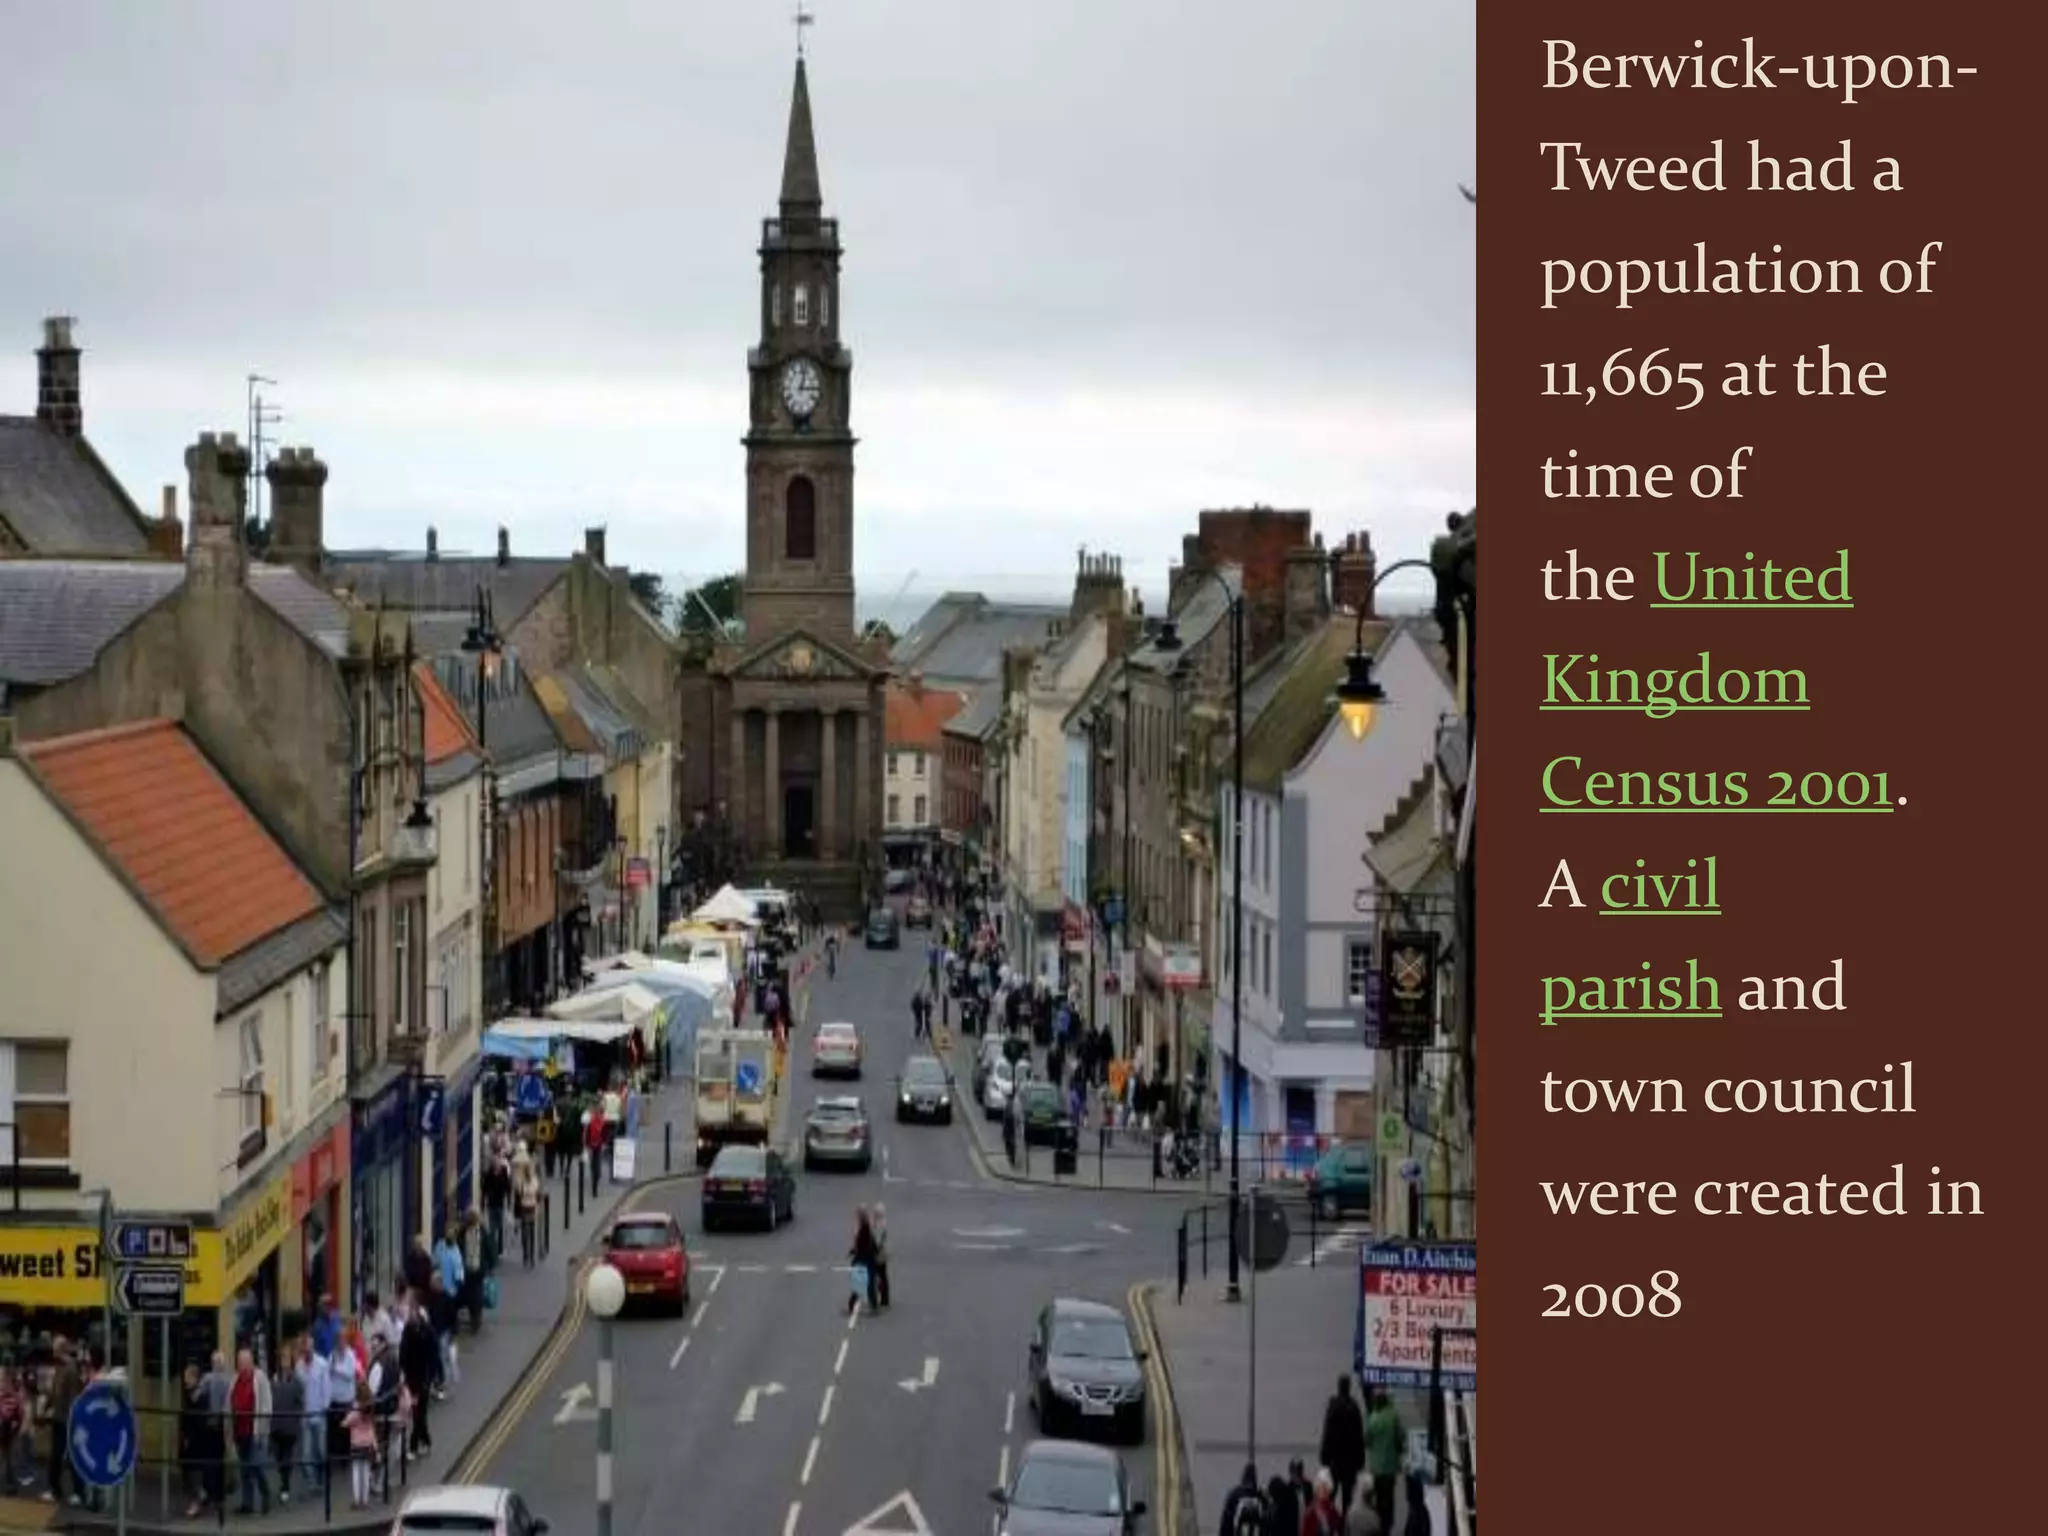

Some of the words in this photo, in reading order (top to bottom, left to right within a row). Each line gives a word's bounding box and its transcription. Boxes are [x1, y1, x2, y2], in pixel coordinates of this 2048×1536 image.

[1380, 1271, 1422, 1295] FOR
[1426, 1274, 1476, 1300] SALE
[1405, 1300, 1465, 1325] Luxury
[1373, 1318, 1399, 1339] 2/3
[1378, 1340, 1476, 1364] Apartents
